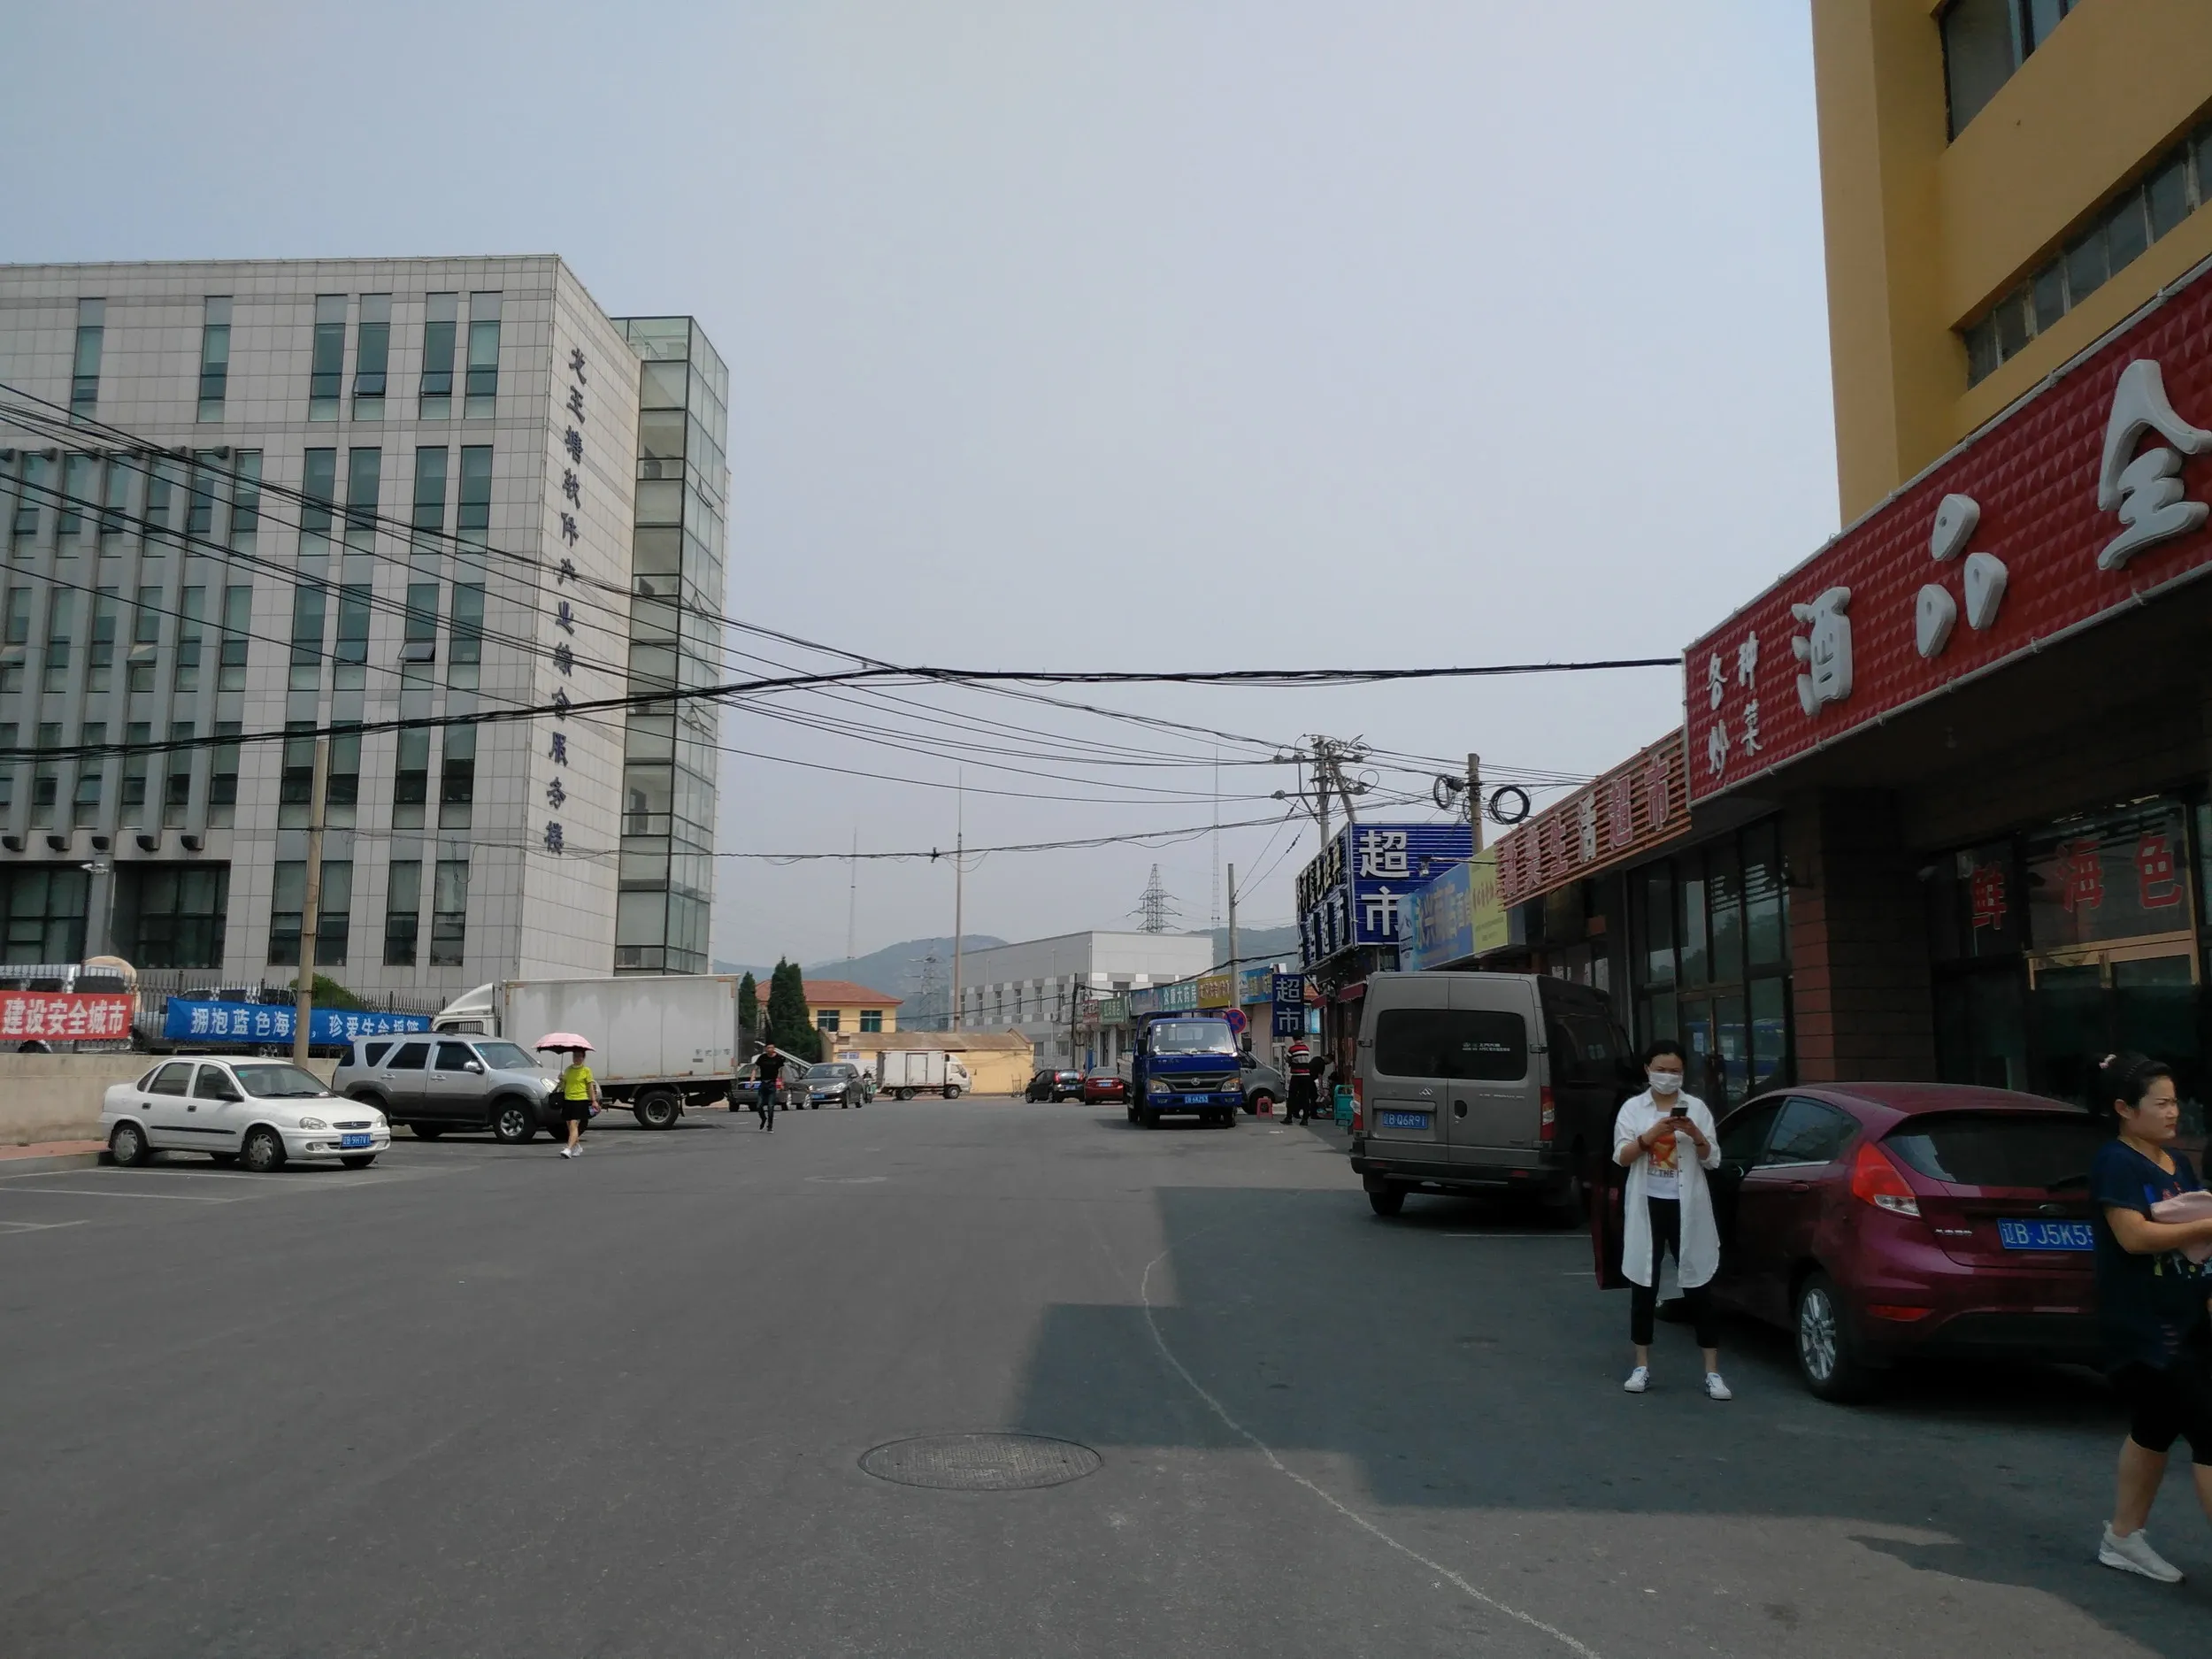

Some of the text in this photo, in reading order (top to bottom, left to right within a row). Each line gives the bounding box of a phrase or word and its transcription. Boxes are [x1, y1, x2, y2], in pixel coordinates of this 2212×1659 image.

[2, 997, 127, 1034] 建设安全城市
[1275, 979, 1302, 1033] 超市
